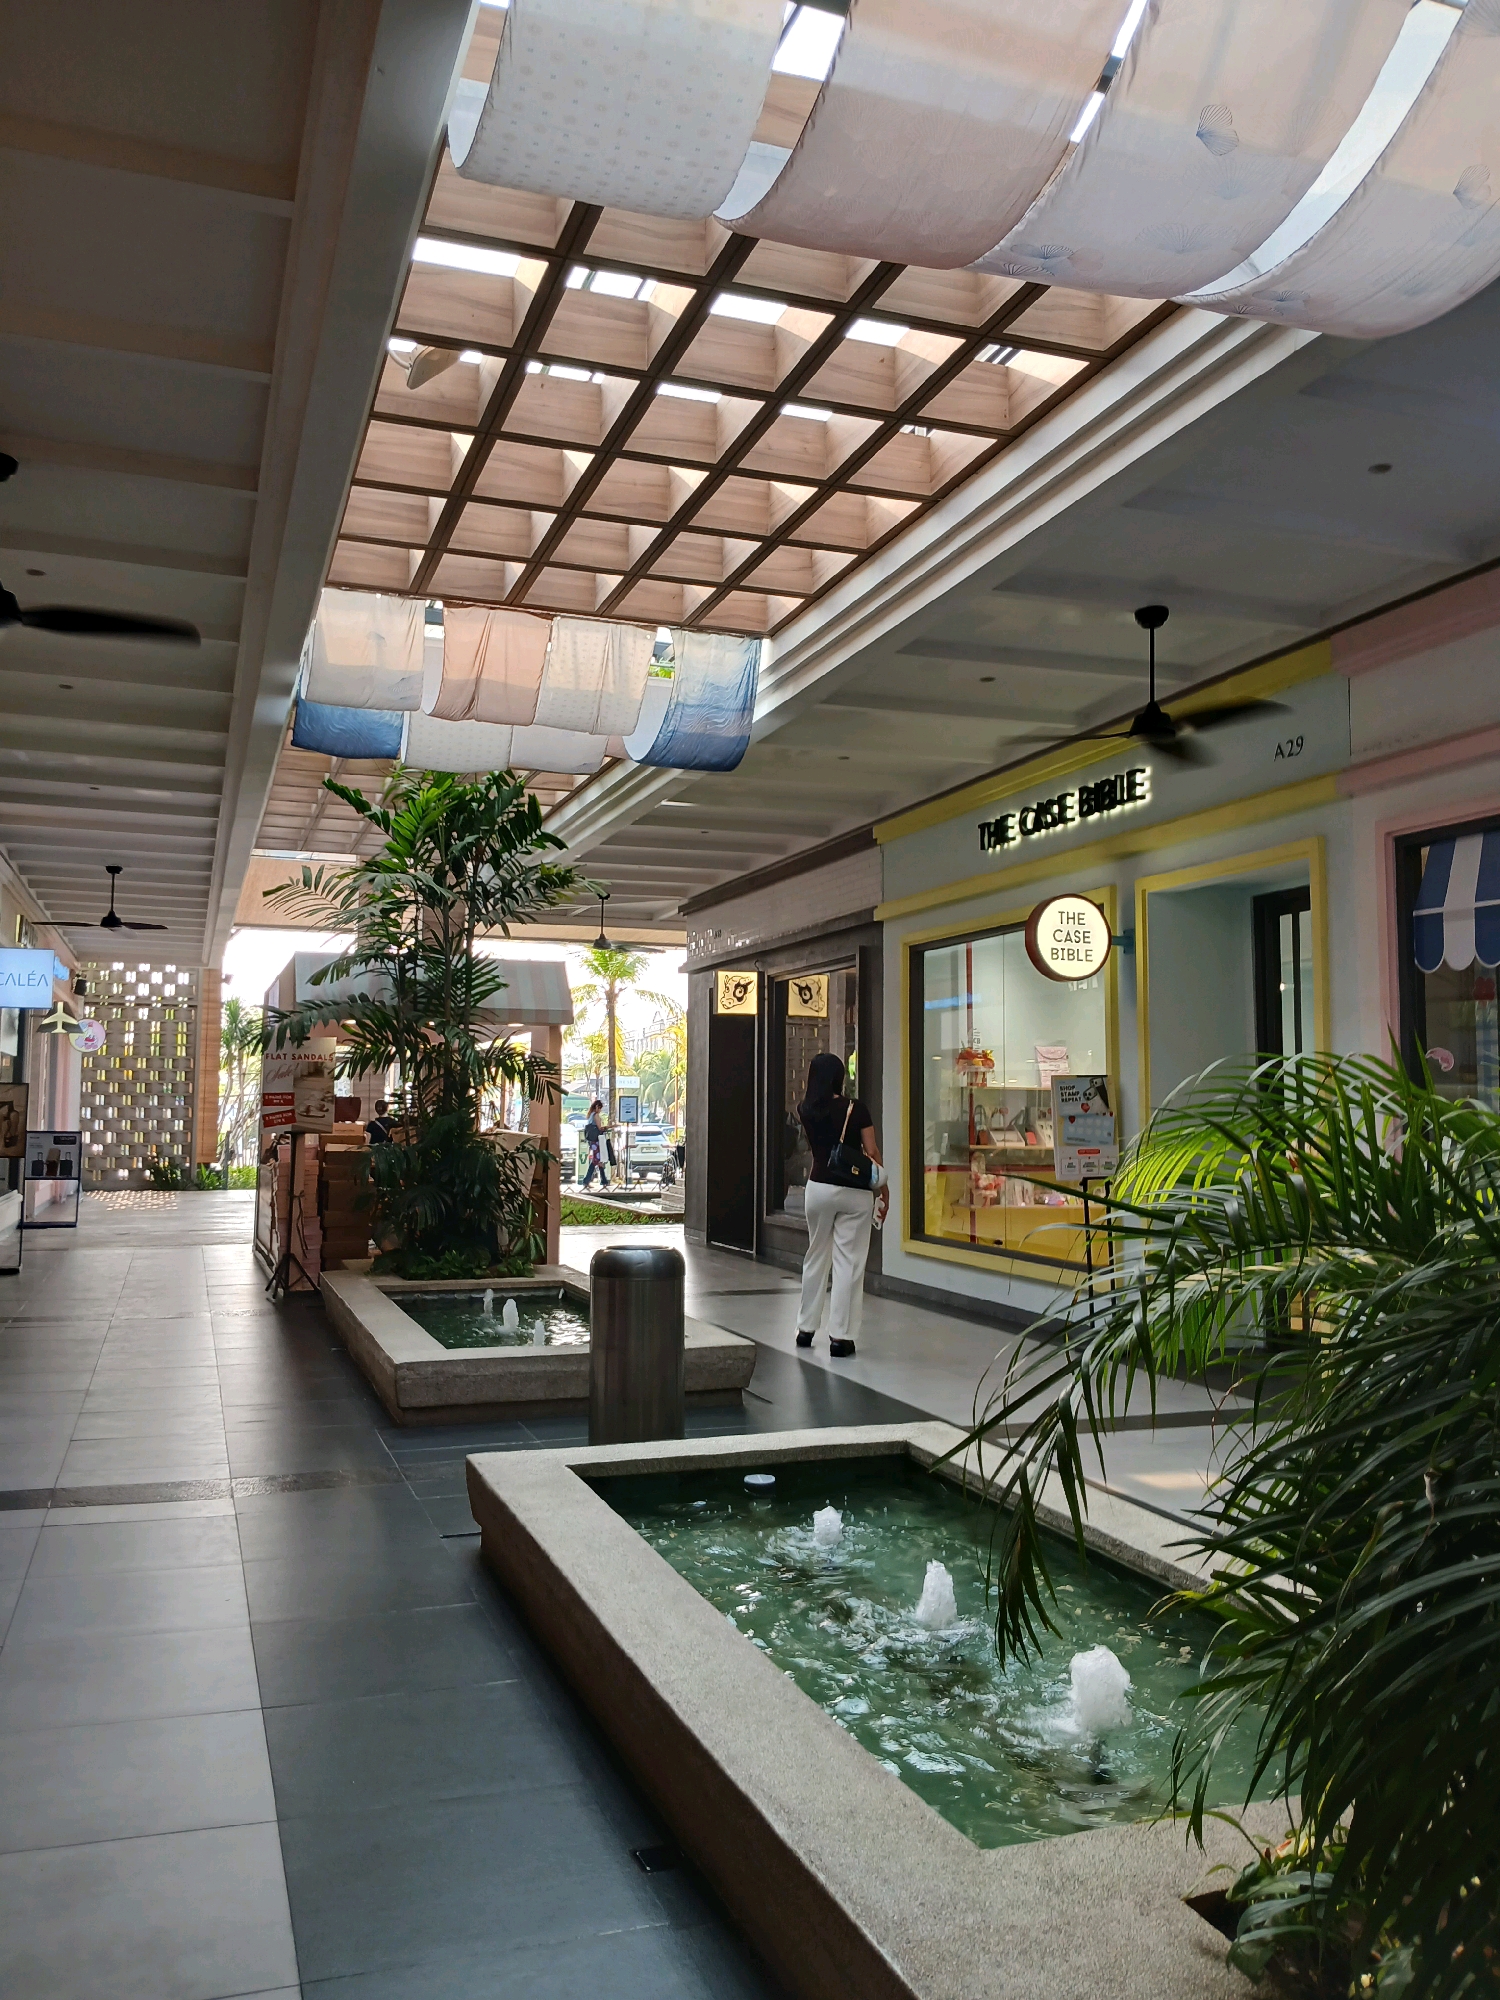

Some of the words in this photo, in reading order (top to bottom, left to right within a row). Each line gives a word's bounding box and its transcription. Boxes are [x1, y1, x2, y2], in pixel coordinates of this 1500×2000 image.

[1273, 735, 1304, 762] A29
[978, 813, 1017, 851] THE
[1019, 792, 1076, 836] CASE
[1078, 768, 1147, 818] BIBLE
[1058, 910, 1086, 926] THE
[1052, 928, 1092, 944] CASE
[1050, 947, 1094, 963] BIBLE
[265, 1052, 288, 1060] FLAT
[291, 1053, 334, 1062] SANDALS
